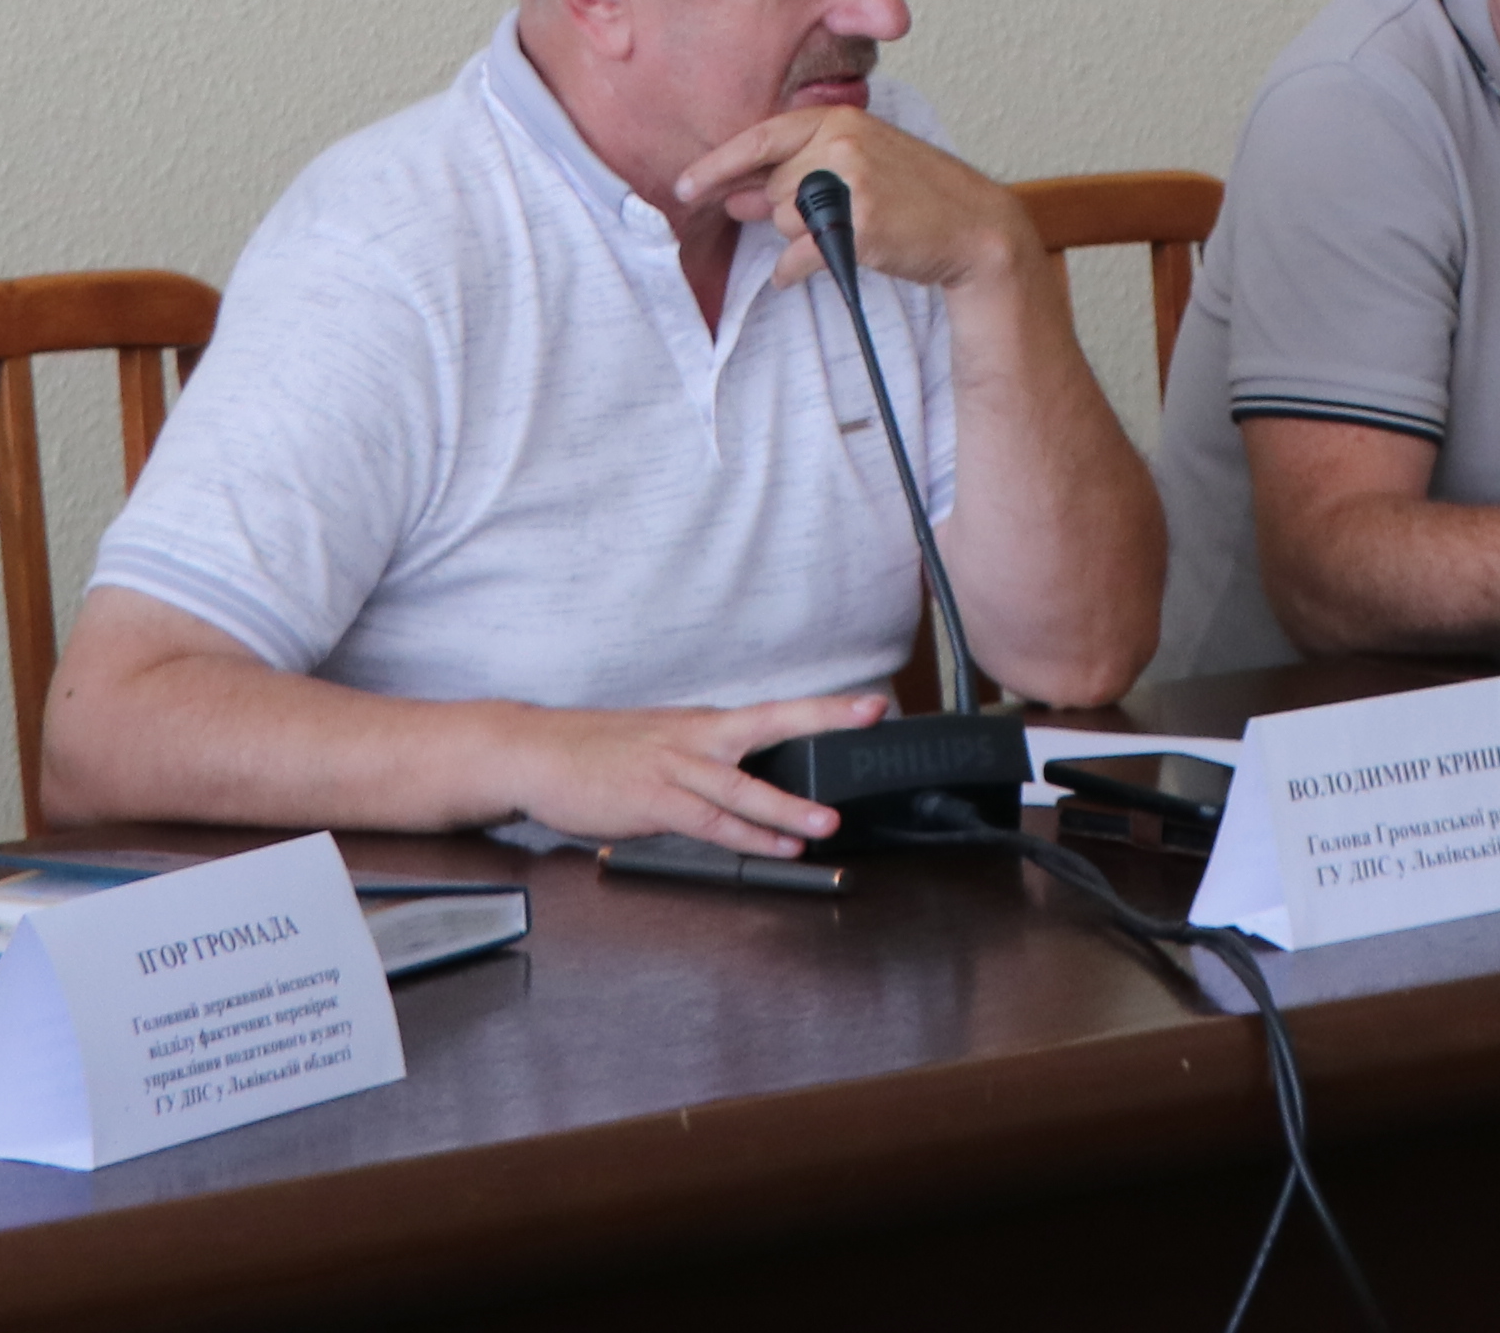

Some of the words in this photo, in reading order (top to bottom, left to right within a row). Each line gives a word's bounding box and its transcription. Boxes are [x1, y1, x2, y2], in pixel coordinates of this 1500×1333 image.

[850, 734, 996, 779] PHILIPS
[1288, 757, 1430, 802] ВОЛОДИМИР
[1307, 829, 1372, 856] Голова
[1374, 809, 1485, 849] Громадської
[1316, 864, 1344, 887] ГУ
[1350, 859, 1392, 885] ДПС
[1396, 857, 1408, 879] у
[135, 940, 189, 975] ІГОР
[192, 914, 300, 961] ГРОМАДА
[132, 1001, 199, 1035] Головний
[202, 982, 274, 1018] державний
[275, 966, 341, 997] інспектор
[149, 1032, 197, 1060] відділу
[198, 1015, 272, 1049] фактичних
[274, 995, 339, 1027] перевірок
[143, 1052, 222, 1094] управління
[224, 1031, 308, 1067] податкового
[154, 1091, 177, 1116] ГУ
[180, 1082, 214, 1111] ДПС
[216, 1083, 226, 1102] у
[227, 1054, 302, 1096] Львівській
[303, 1044, 353, 1074] області
